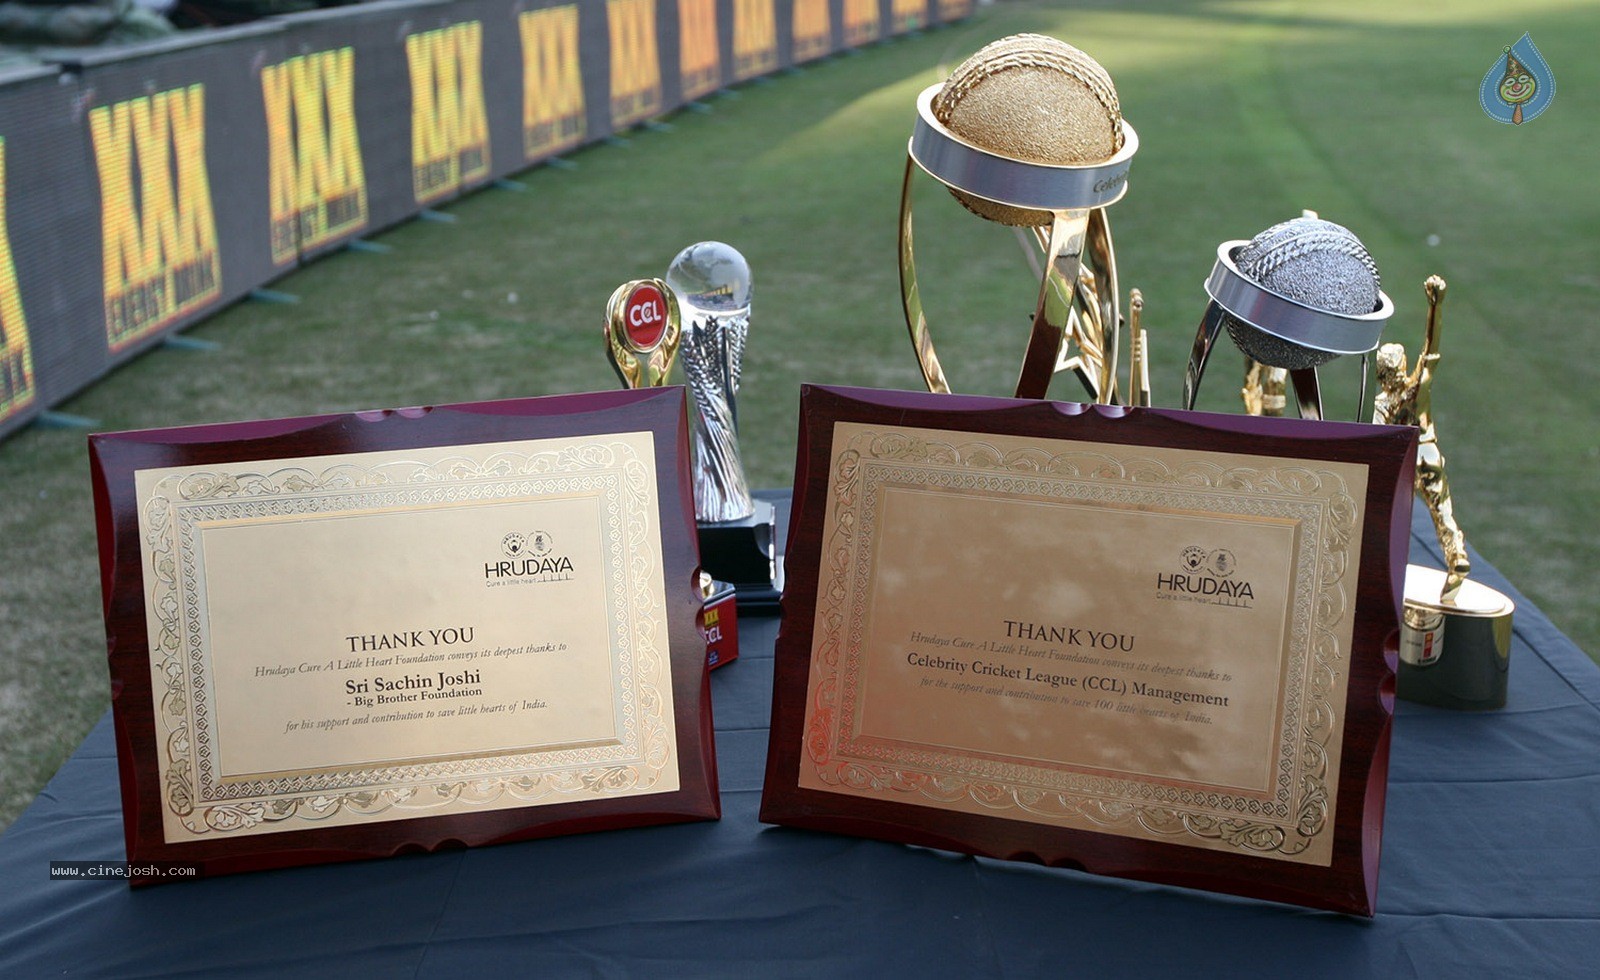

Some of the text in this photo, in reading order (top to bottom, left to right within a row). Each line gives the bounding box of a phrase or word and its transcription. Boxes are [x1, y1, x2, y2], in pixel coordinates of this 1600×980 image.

[89, 83, 217, 298] XXX
[630, 300, 661, 327] CCL
[485, 556, 574, 578] HRUDAYA
[1157, 572, 1254, 600] HRUDAYA
[346, 627, 474, 652] THANK YOU
[705, 626, 722, 644] CL
[1004, 620, 1134, 652] THANK YOU
[255, 642, 567, 678] Hrudaya Cure A Little Heart Foundation conveys its deepest thanks to
[910, 631, 950, 648] Hrudaya
[952, 637, 975, 649] Cure
[978, 640, 988, 651] A
[990, 641, 1015, 654] Little
[1018, 645, 1046, 659] Heart
[1048, 649, 1100, 665] Foundation
[1137, 660, 1149, 672] its
[1151, 662, 1184, 677] deepest
[1186, 667, 1219, 681] thanks
[1222, 672, 1232, 681] to
[345, 669, 481, 694] Sri Sachin Joshi
[907, 652, 1229, 707] Celebrity Cricket League (CCL) Management
[354, 696, 374, 708] Big
[377, 692, 418, 704] Brother
[421, 687, 482, 701] Foundation
[951, 680, 984, 695] support
[985, 685, 1003, 696] and
[1094, 698, 1113, 710] 100
[283, 699, 548, 734] for his support and contribution to save little hearts of India.
